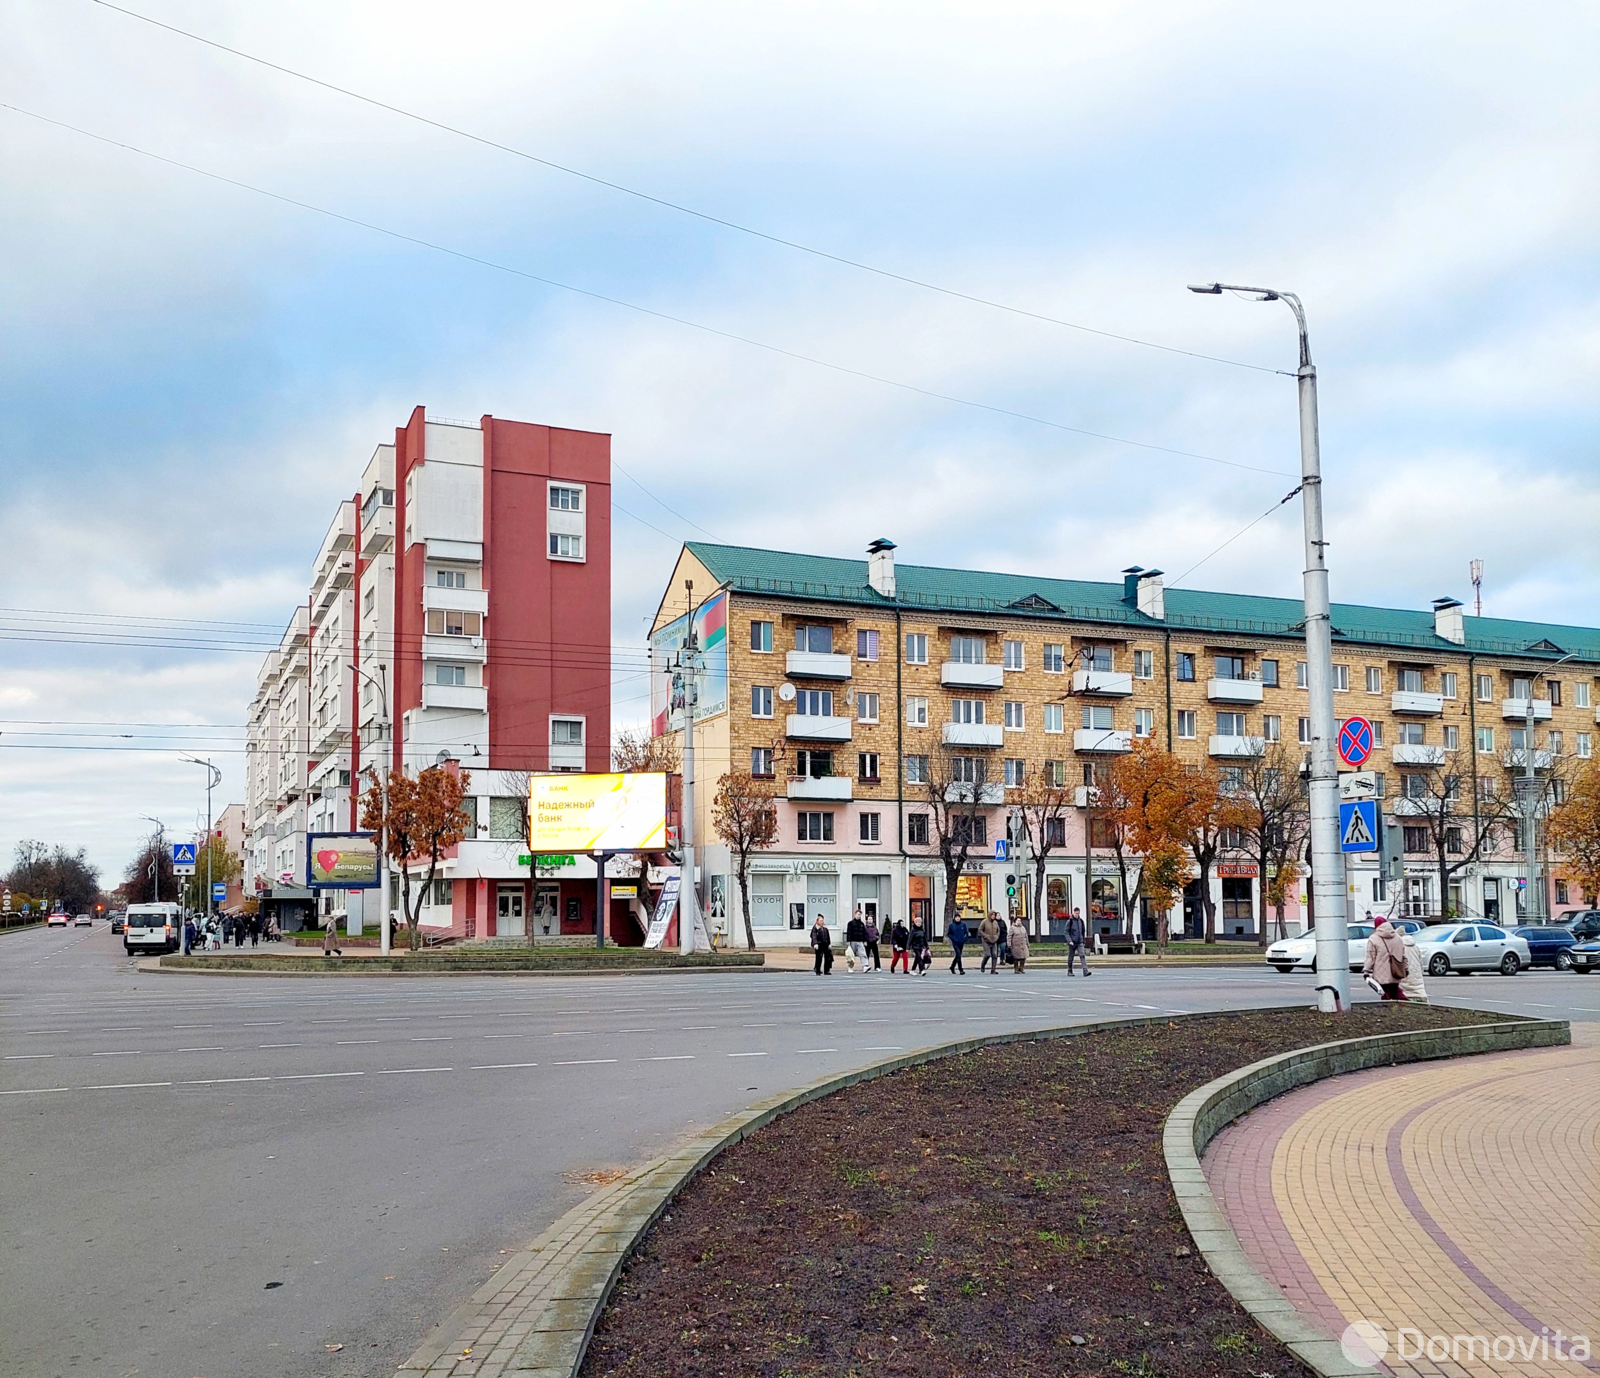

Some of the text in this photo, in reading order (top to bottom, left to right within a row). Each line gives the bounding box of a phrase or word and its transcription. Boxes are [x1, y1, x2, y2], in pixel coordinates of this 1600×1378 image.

[537, 799, 595, 811] Надежный
[537, 813, 563, 823] банк
[334, 863, 374, 871] Беларусь!
[799, 861, 837, 871] ЛОКОН
